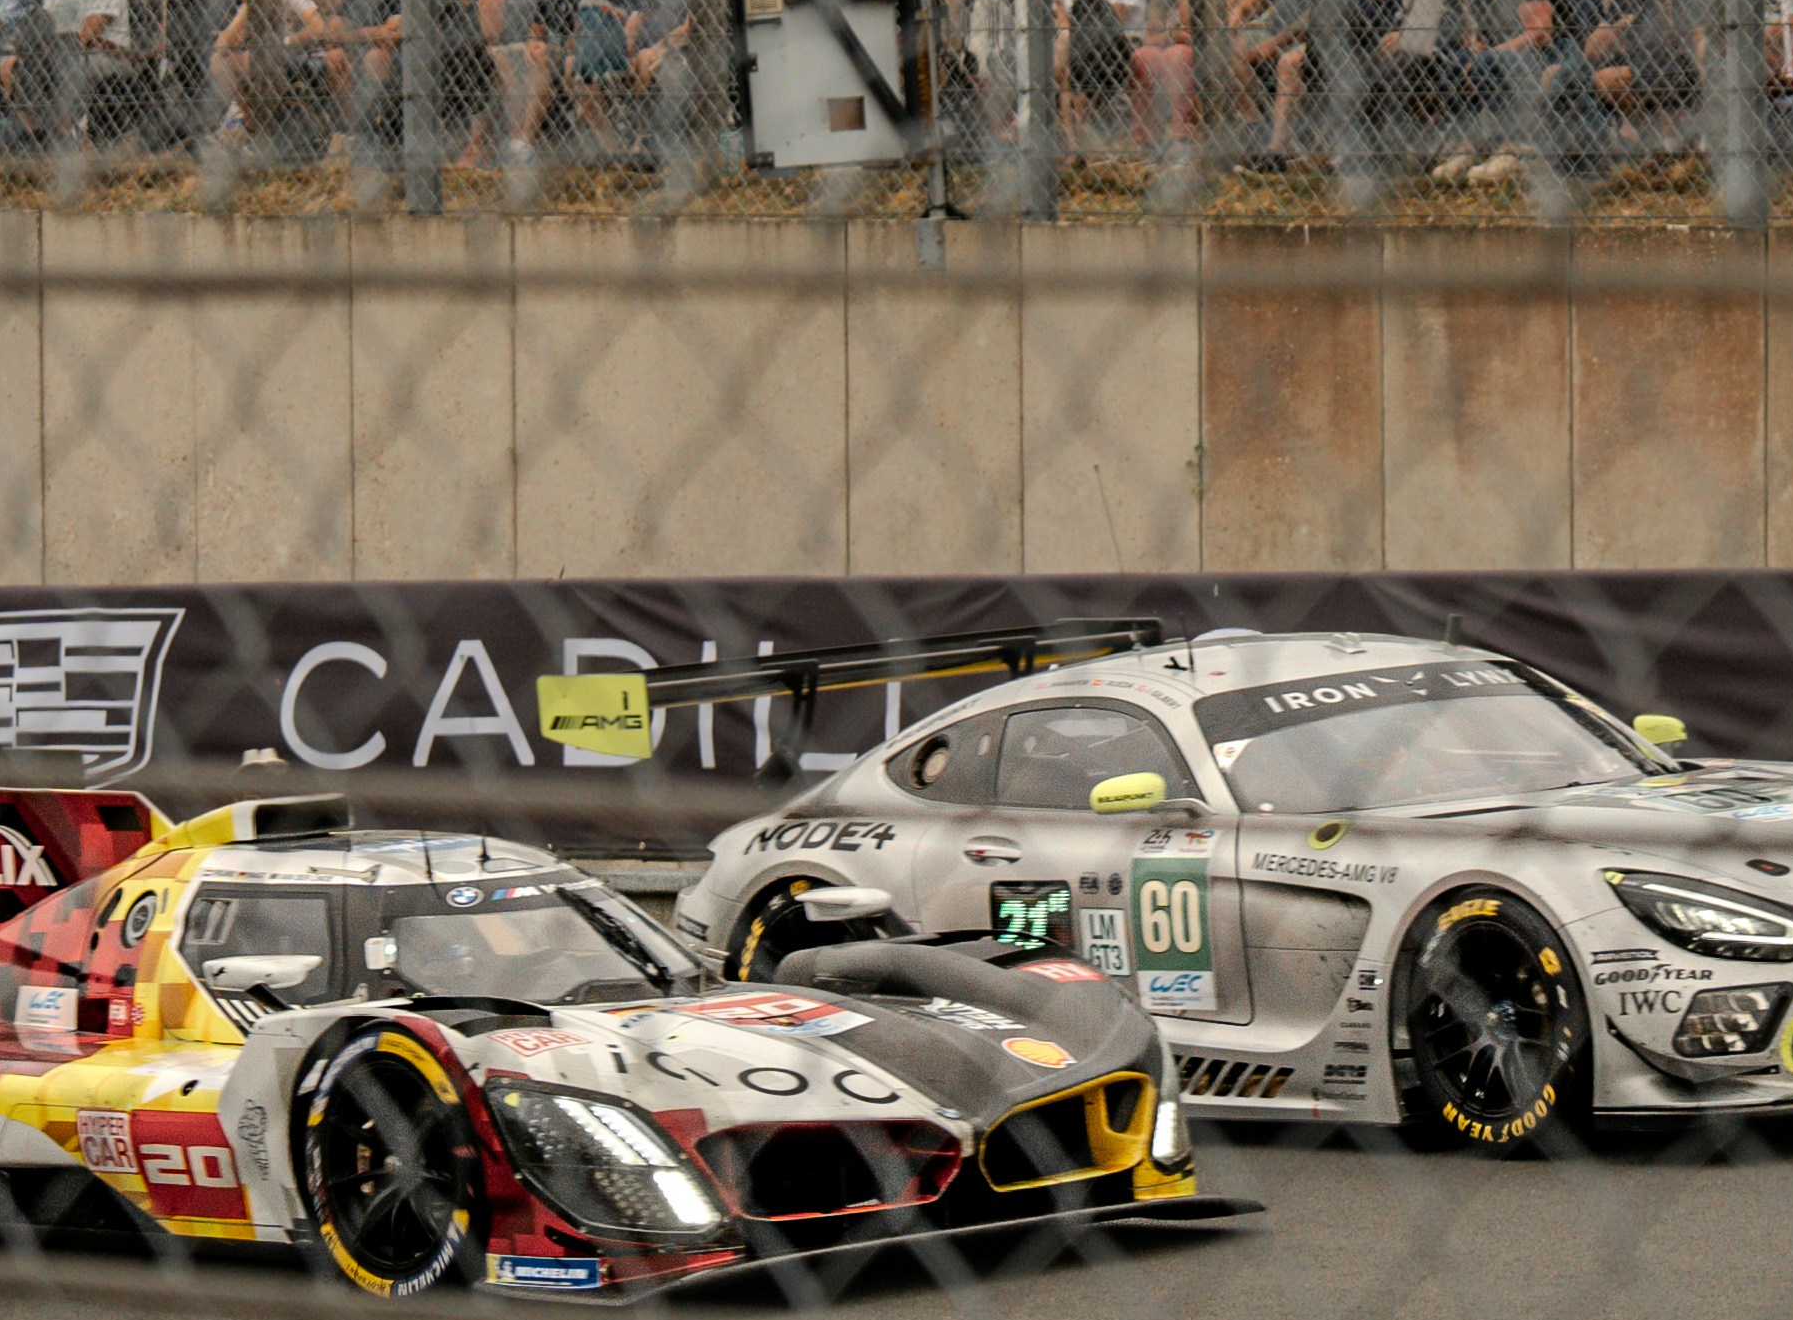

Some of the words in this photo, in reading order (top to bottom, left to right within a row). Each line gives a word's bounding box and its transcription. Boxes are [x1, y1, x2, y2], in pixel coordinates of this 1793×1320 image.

[1263, 682, 1377, 714] IRON
[581, 715, 643, 730] AMG
[1252, 852, 1377, 883] MERCEDES-AMG
[1379, 866, 1399, 884] V8
[1089, 913, 1117, 940] LM
[1140, 879, 1203, 954] 60
[1090, 944, 1123, 970] GT3
[1149, 973, 1204, 993] WEC
[1594, 963, 1714, 986] GOODYEAR
[1618, 989, 1683, 1016] IWC
[84, 1135, 136, 1172] CAR
[138, 1143, 240, 1189] 20
